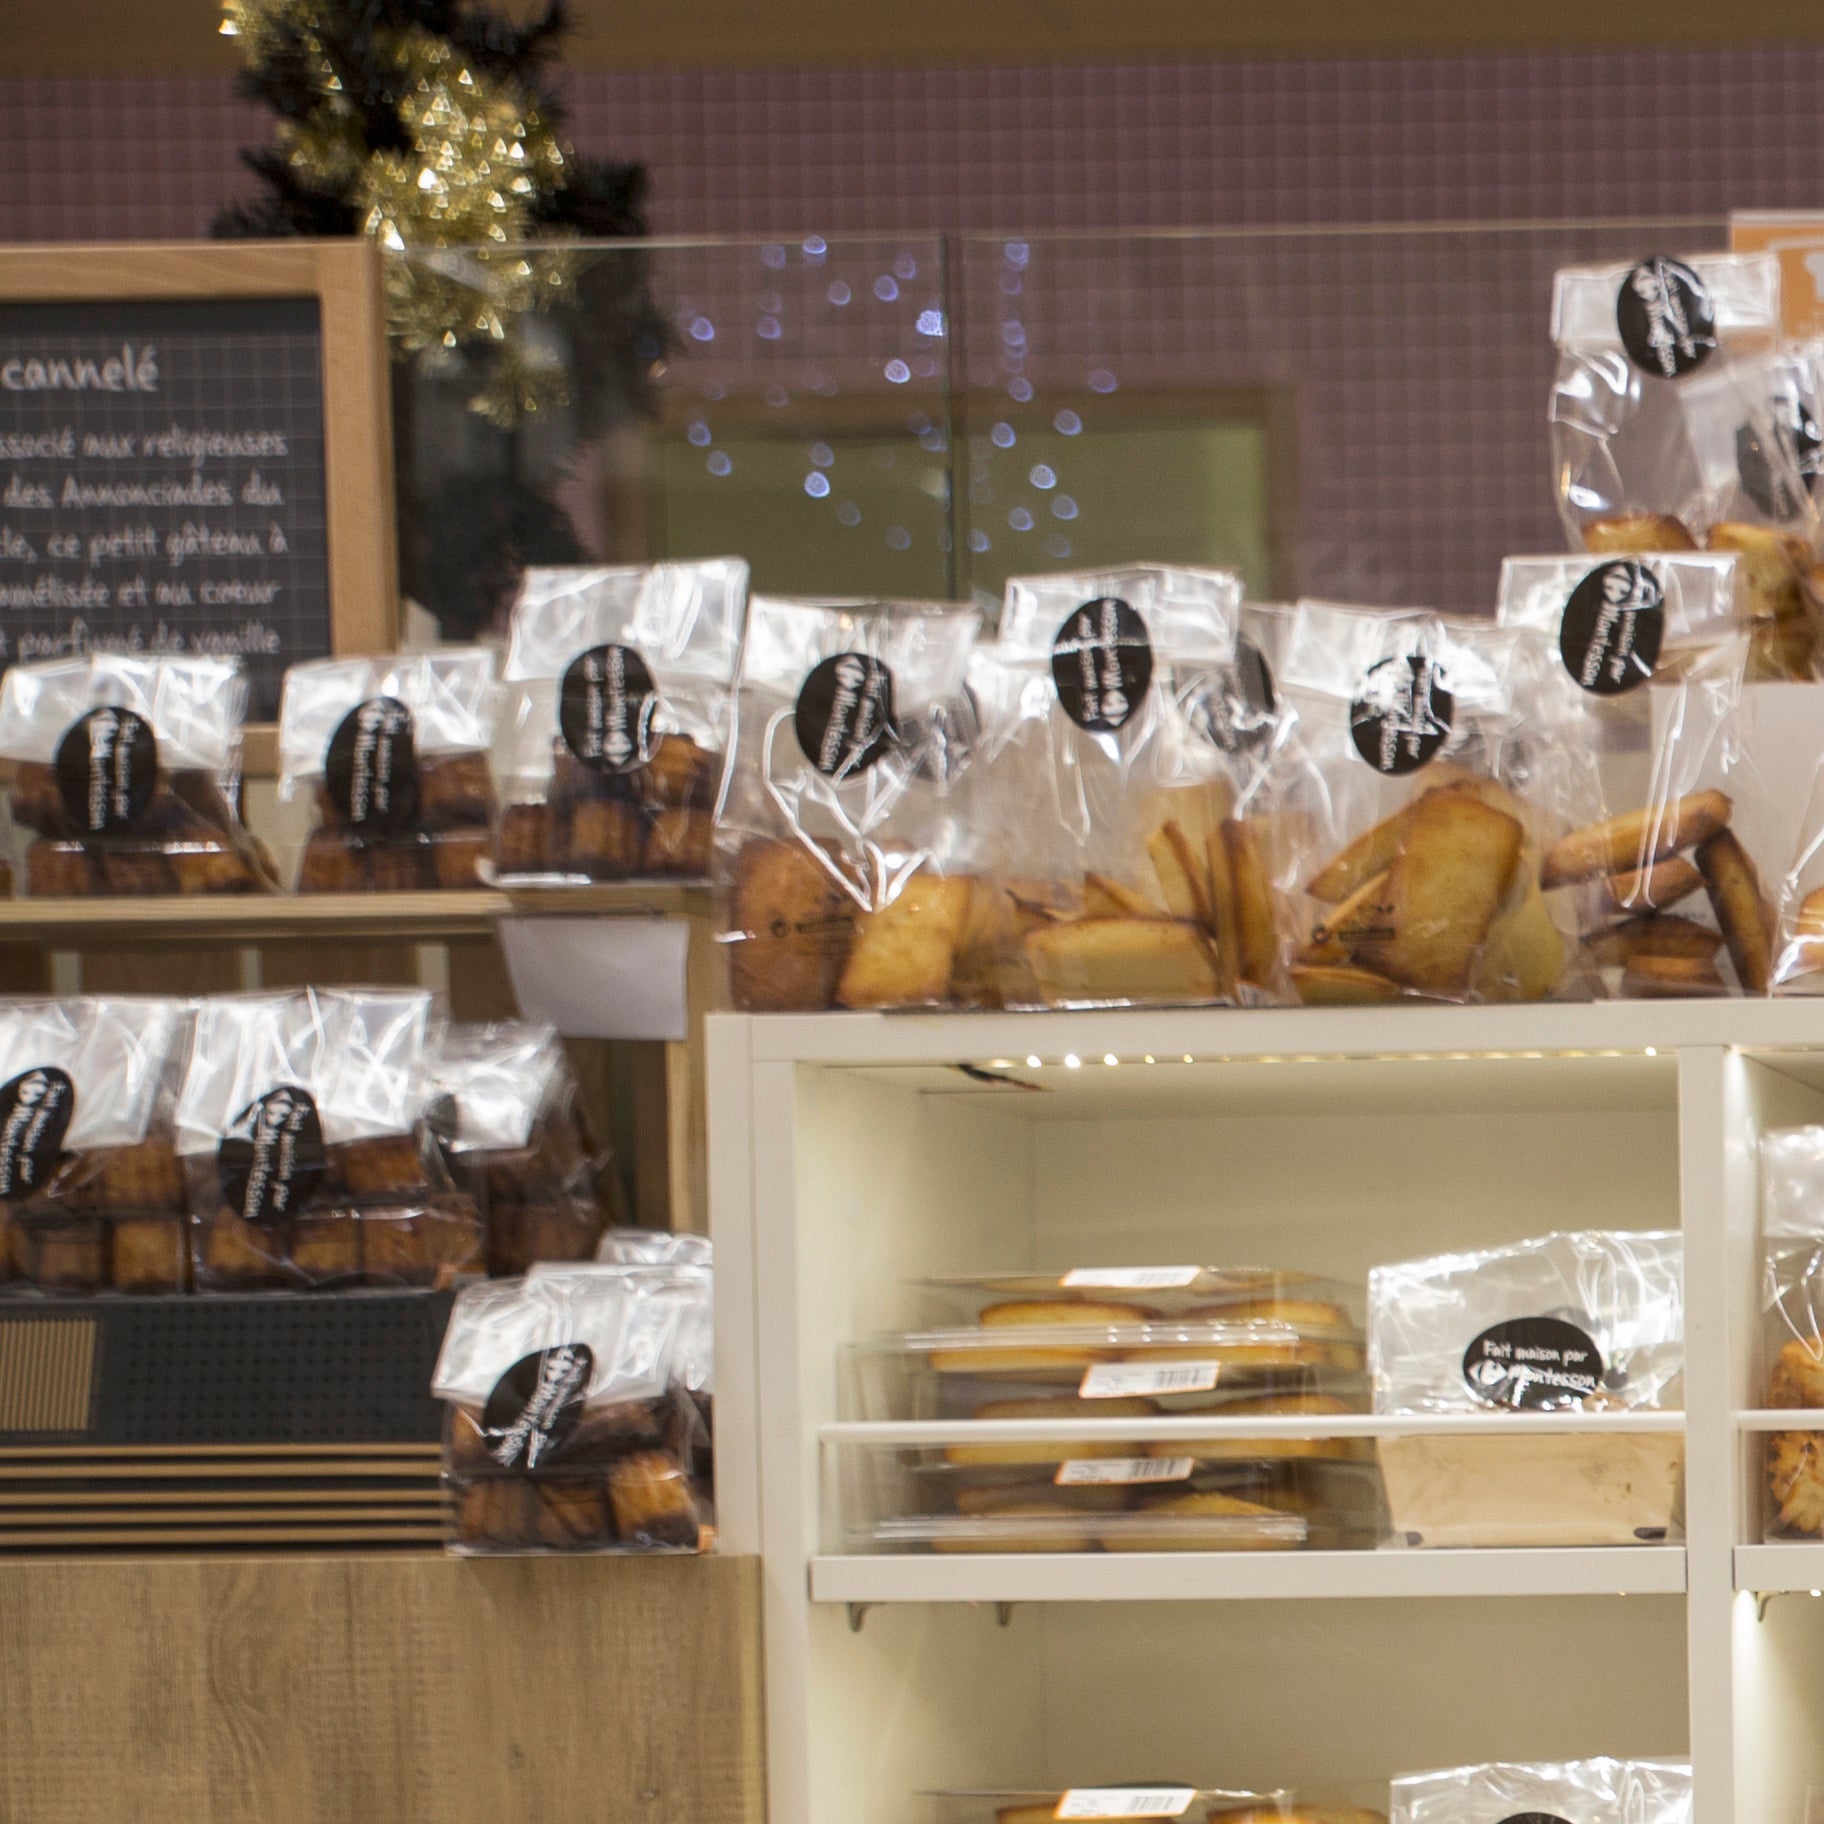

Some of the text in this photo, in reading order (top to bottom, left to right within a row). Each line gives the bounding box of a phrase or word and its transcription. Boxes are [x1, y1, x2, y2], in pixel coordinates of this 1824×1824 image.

[1, 341, 159, 392] cannelé
[83, 432, 135, 460] aux
[142, 421, 289, 469] religieuses
[4, 471, 53, 509] des
[48, 531, 81, 560] ce
[89, 522, 159, 570] petit
[166, 517, 263, 569] gâteau
[117, 572, 148, 607] et
[155, 579, 196, 606] au
[1582, 602, 1621, 687] Montesson
[820, 688, 859, 772] Montesson
[1482, 1340, 1589, 1367] Fait maison par
